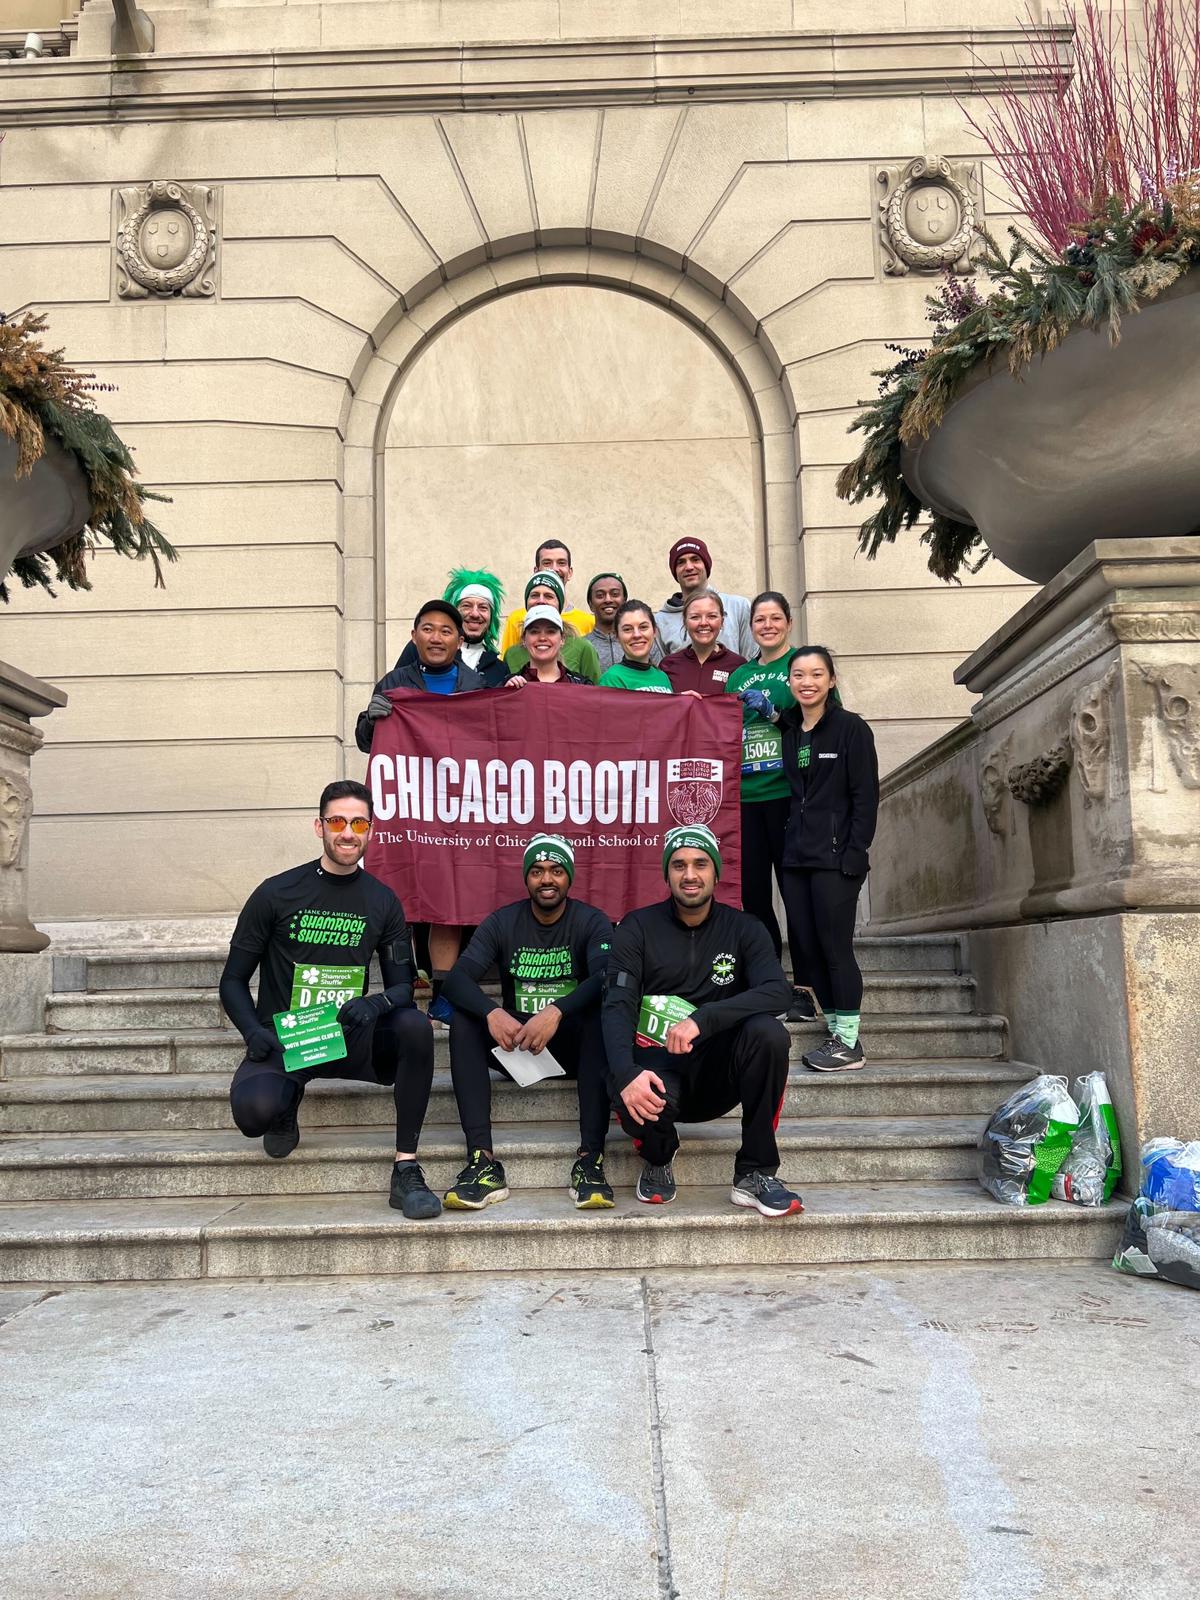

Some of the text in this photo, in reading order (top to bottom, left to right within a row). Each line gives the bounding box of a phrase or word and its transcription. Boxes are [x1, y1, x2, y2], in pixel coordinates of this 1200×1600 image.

[738, 673, 766, 692] Lucky
[776, 671, 788, 682] be
[744, 740, 778, 760] 15042
[370, 753, 660, 825] CHICAGO BOOTH
[375, 831, 403, 844] The
[406, 829, 472, 850] University
[475, 834, 491, 847] of
[598, 834, 641, 847] School
[644, 834, 660, 847] of
[300, 914, 366, 934] SHAMROCK
[331, 911, 357, 919] AMERICA
[300, 988, 311, 1008] D
[520, 997, 529, 1013] E
[297, 1009, 325, 1020] Shamrock
[298, 1016, 319, 1026] Shuffle
[647, 1013, 677, 1040] D 1
[321, 1033, 334, 1041] CLUB
